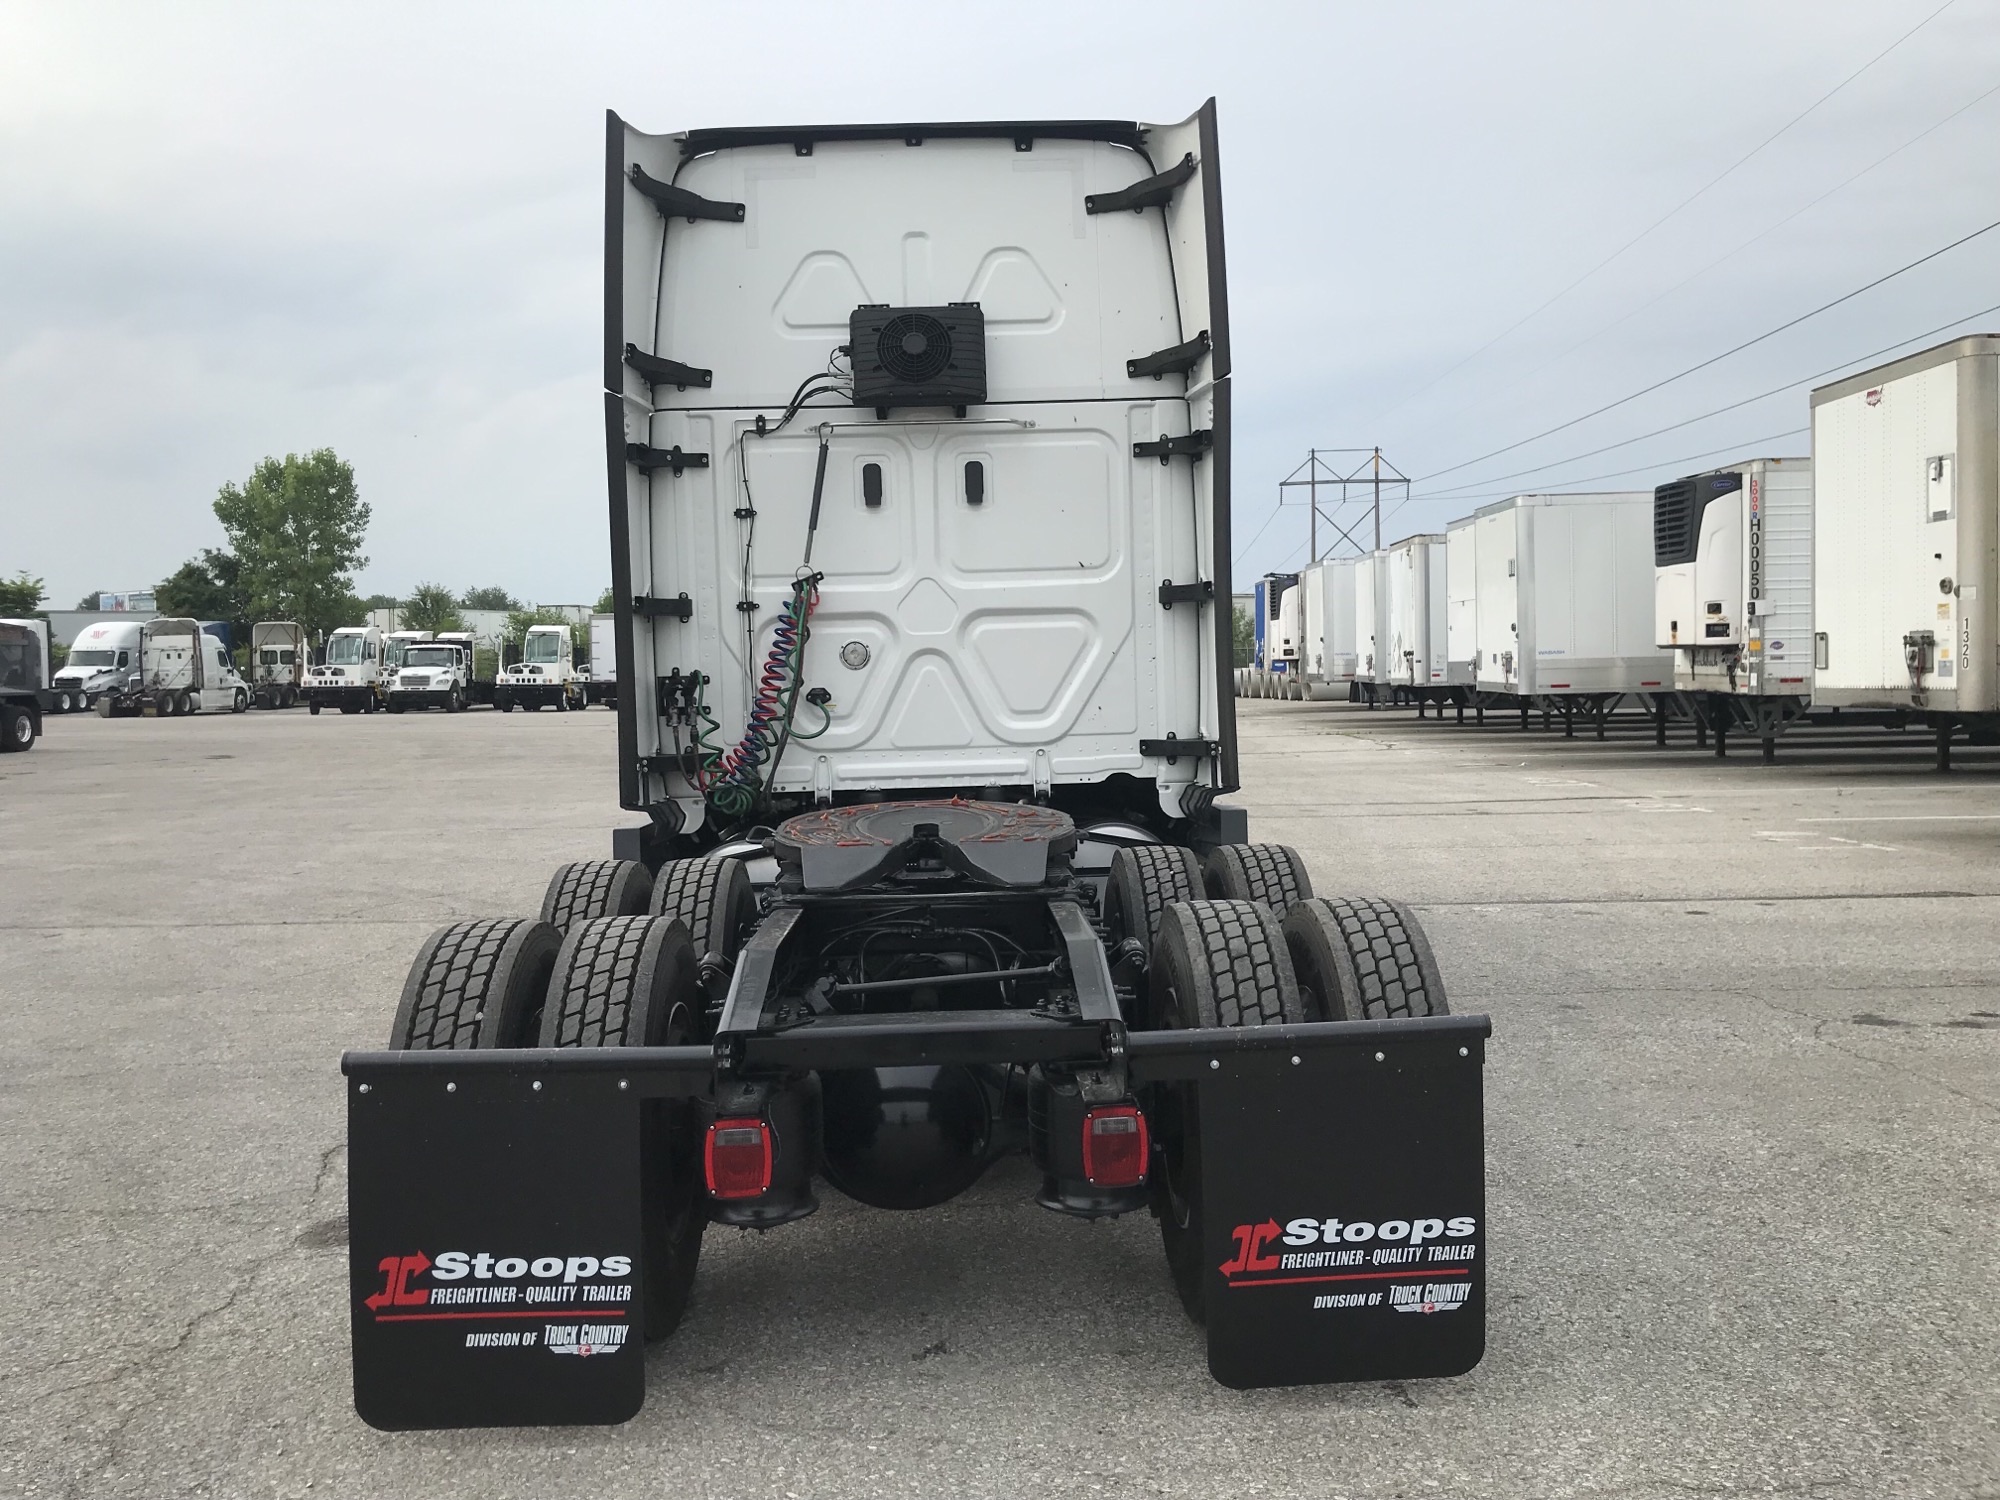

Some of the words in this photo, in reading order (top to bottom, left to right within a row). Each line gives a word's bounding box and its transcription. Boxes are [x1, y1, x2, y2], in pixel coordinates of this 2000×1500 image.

[1750, 519, 1761, 600] H00050
[1962, 617, 1970, 669] 1320
[1283, 1217, 1476, 1245] Stoops
[1428, 1245, 1475, 1261] TRAILER
[432, 1252, 631, 1283] Stoops
[583, 1286, 631, 1301] TRAILER
[1314, 1294, 1366, 1308] DIVISION
[1368, 1293, 1383, 1305] OF
[1389, 1285, 1423, 1303] TRUCK
[1424, 1283, 1472, 1302] COUNTRY
[466, 1333, 520, 1347] DIVISION
[522, 1332, 537, 1345] OF
[544, 1325, 578, 1344] TRUCK
[580, 1324, 629, 1344] COUNTRY
